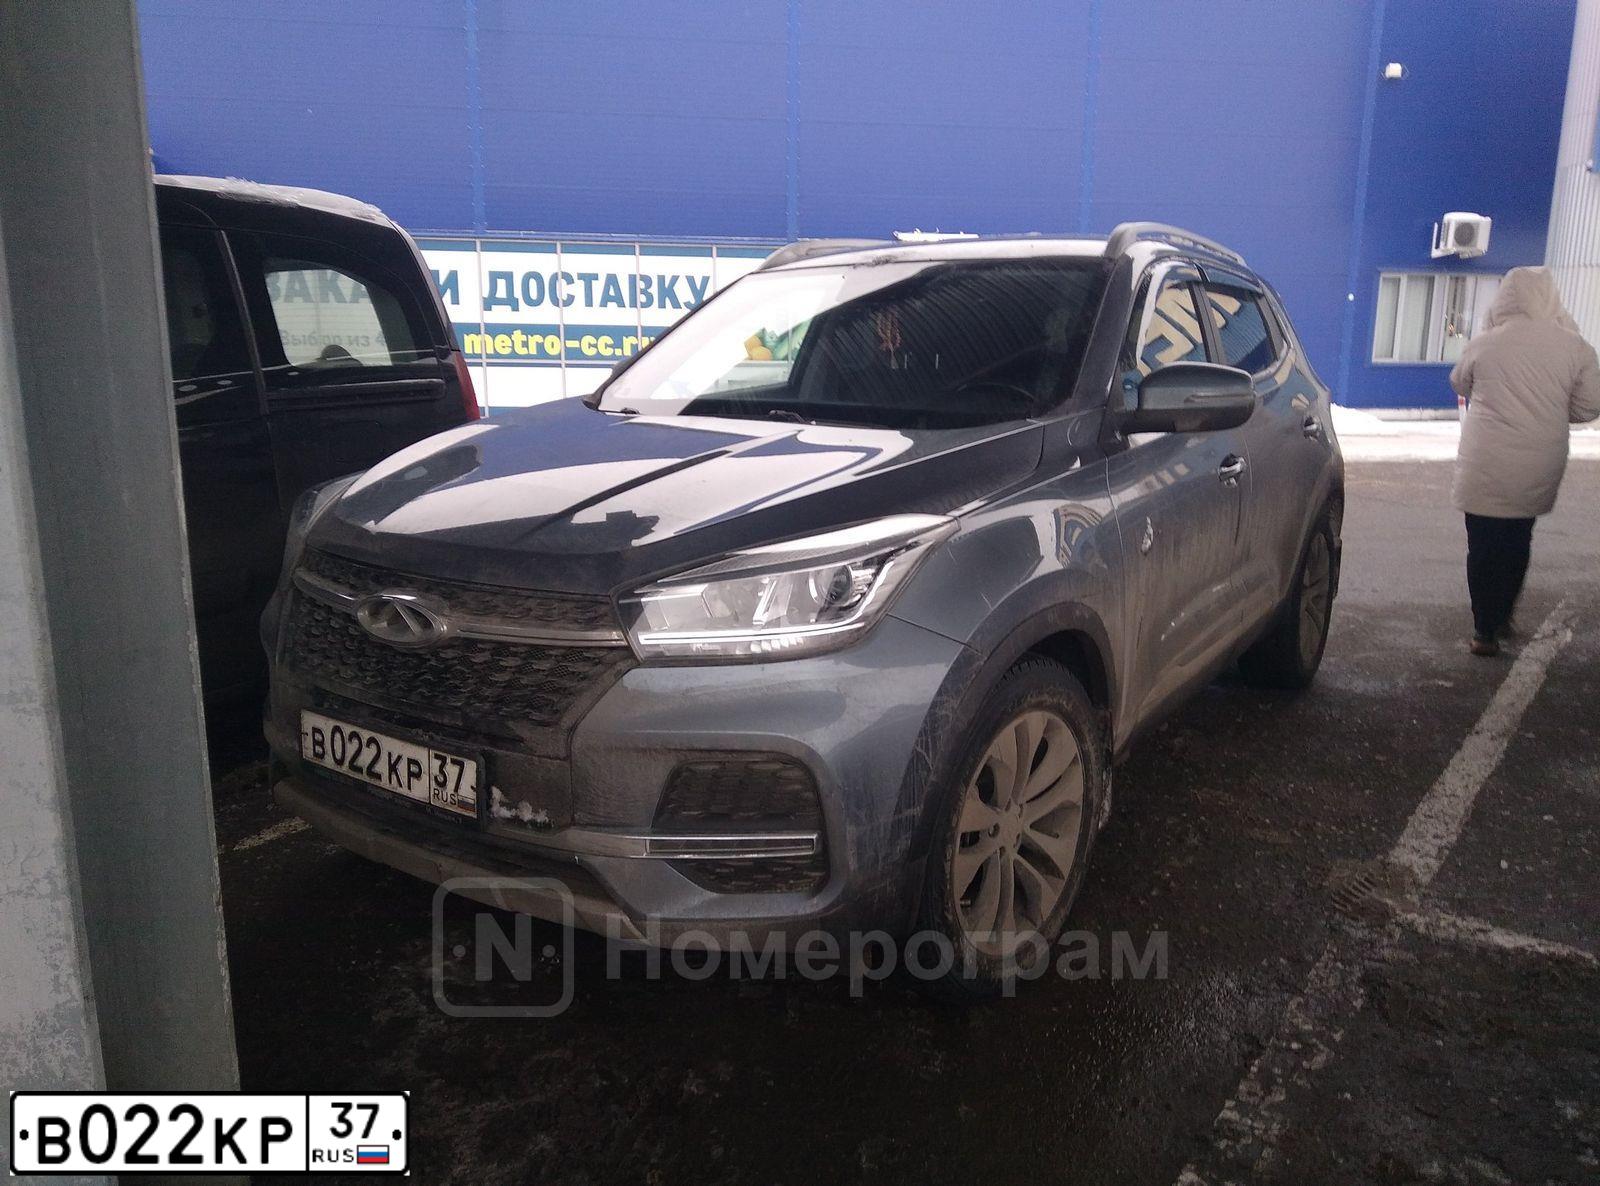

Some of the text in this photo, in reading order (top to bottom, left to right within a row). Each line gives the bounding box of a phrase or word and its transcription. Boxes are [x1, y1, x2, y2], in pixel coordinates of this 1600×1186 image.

[482, 270, 710, 312] ДОСТАВКУ
[433, 752, 466, 793] 37
[432, 787, 458, 807] RUS
